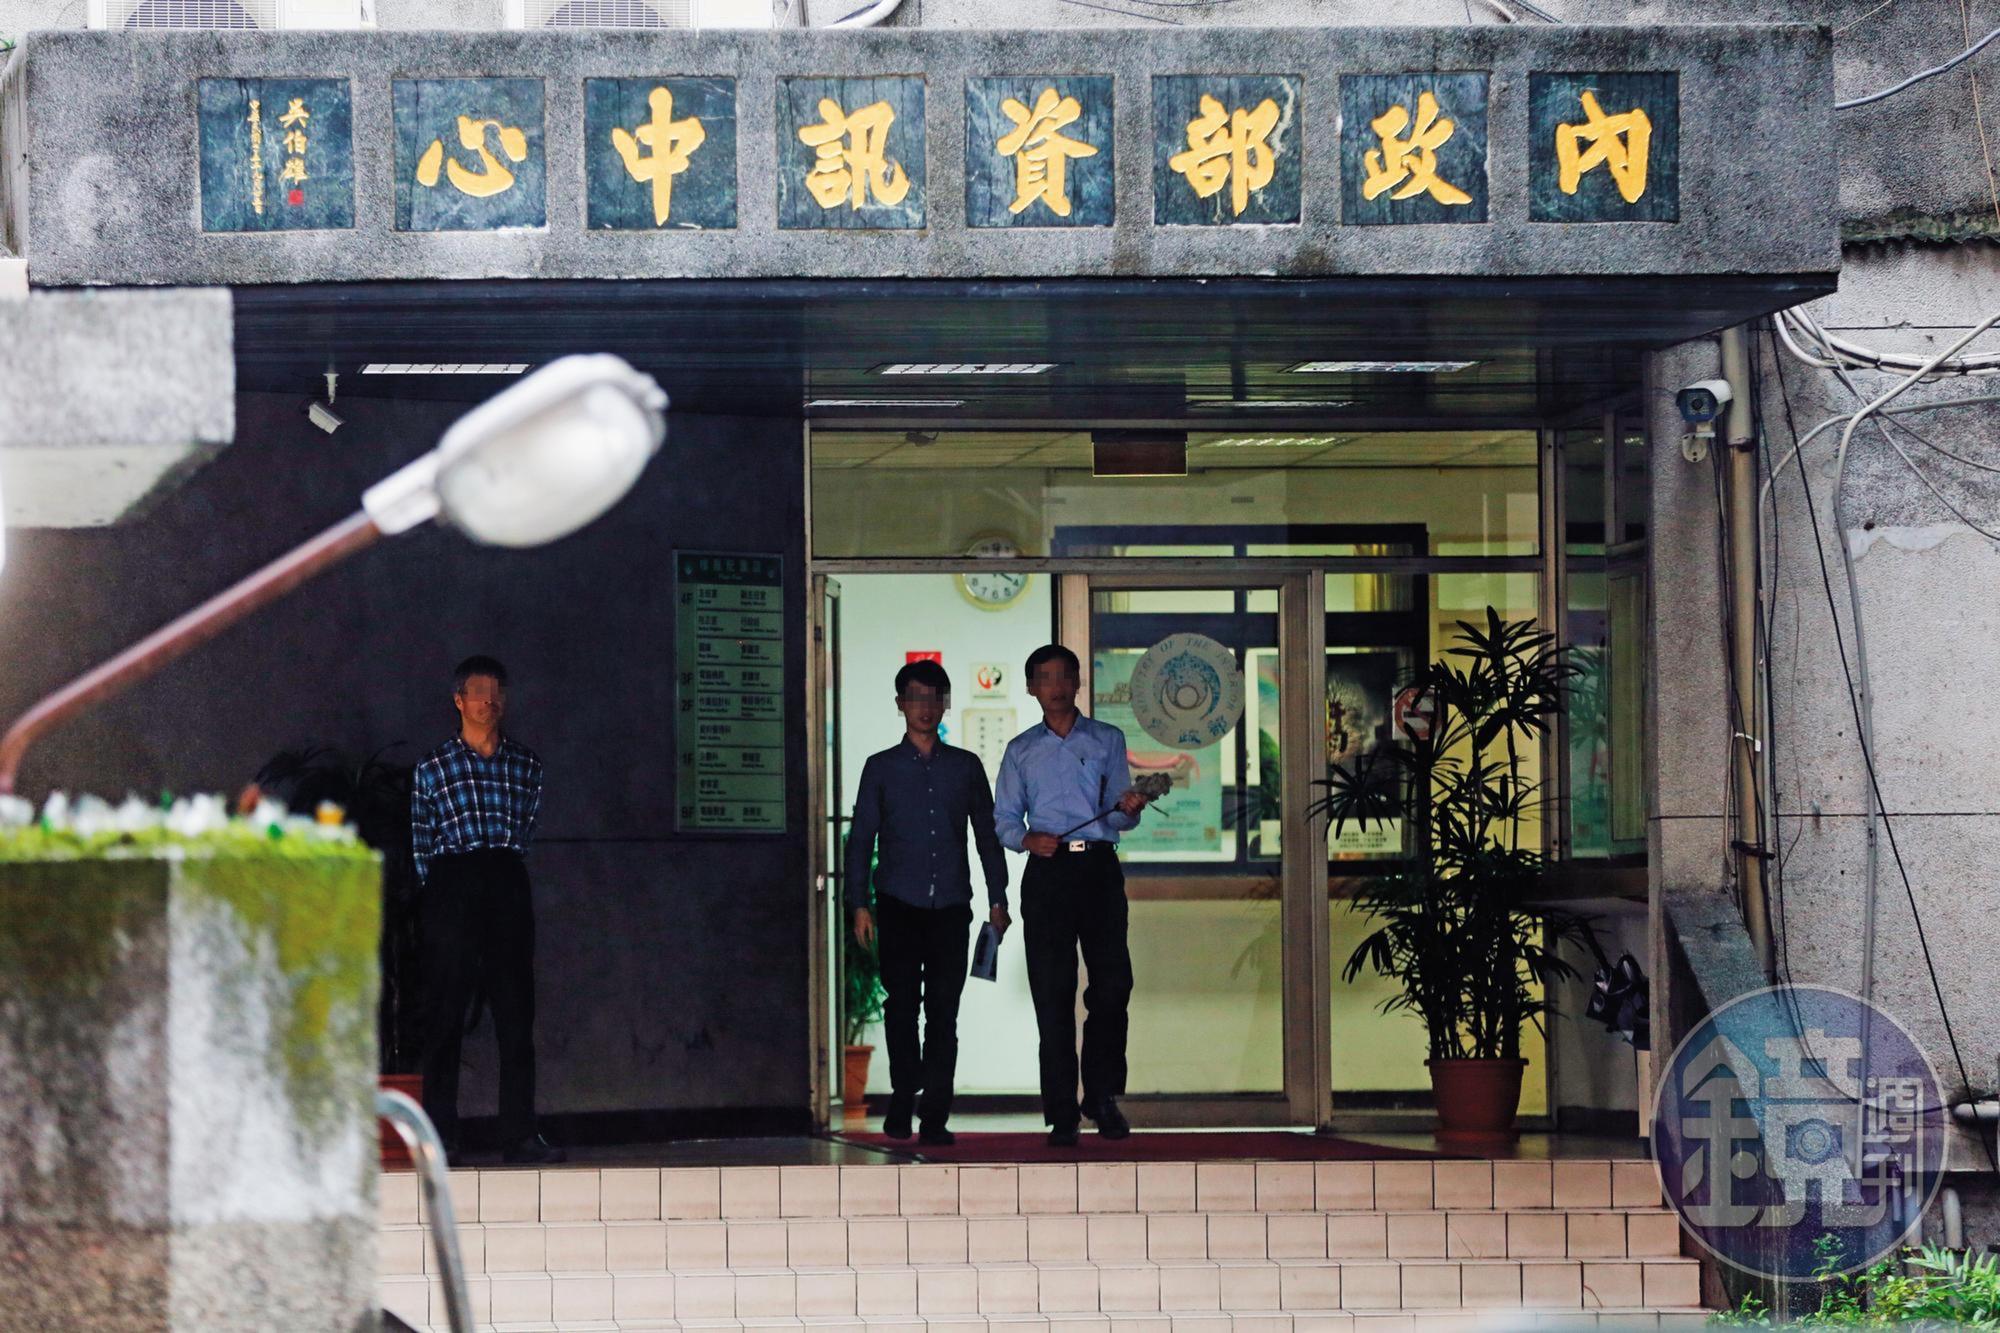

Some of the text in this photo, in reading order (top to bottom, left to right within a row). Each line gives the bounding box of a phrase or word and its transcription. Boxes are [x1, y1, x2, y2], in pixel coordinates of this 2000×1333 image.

[278, 97, 311, 186] 吳伯雄
[416, 85, 1653, 227] 內政部資訊中心
[1159, 639, 1175, 653] OF
